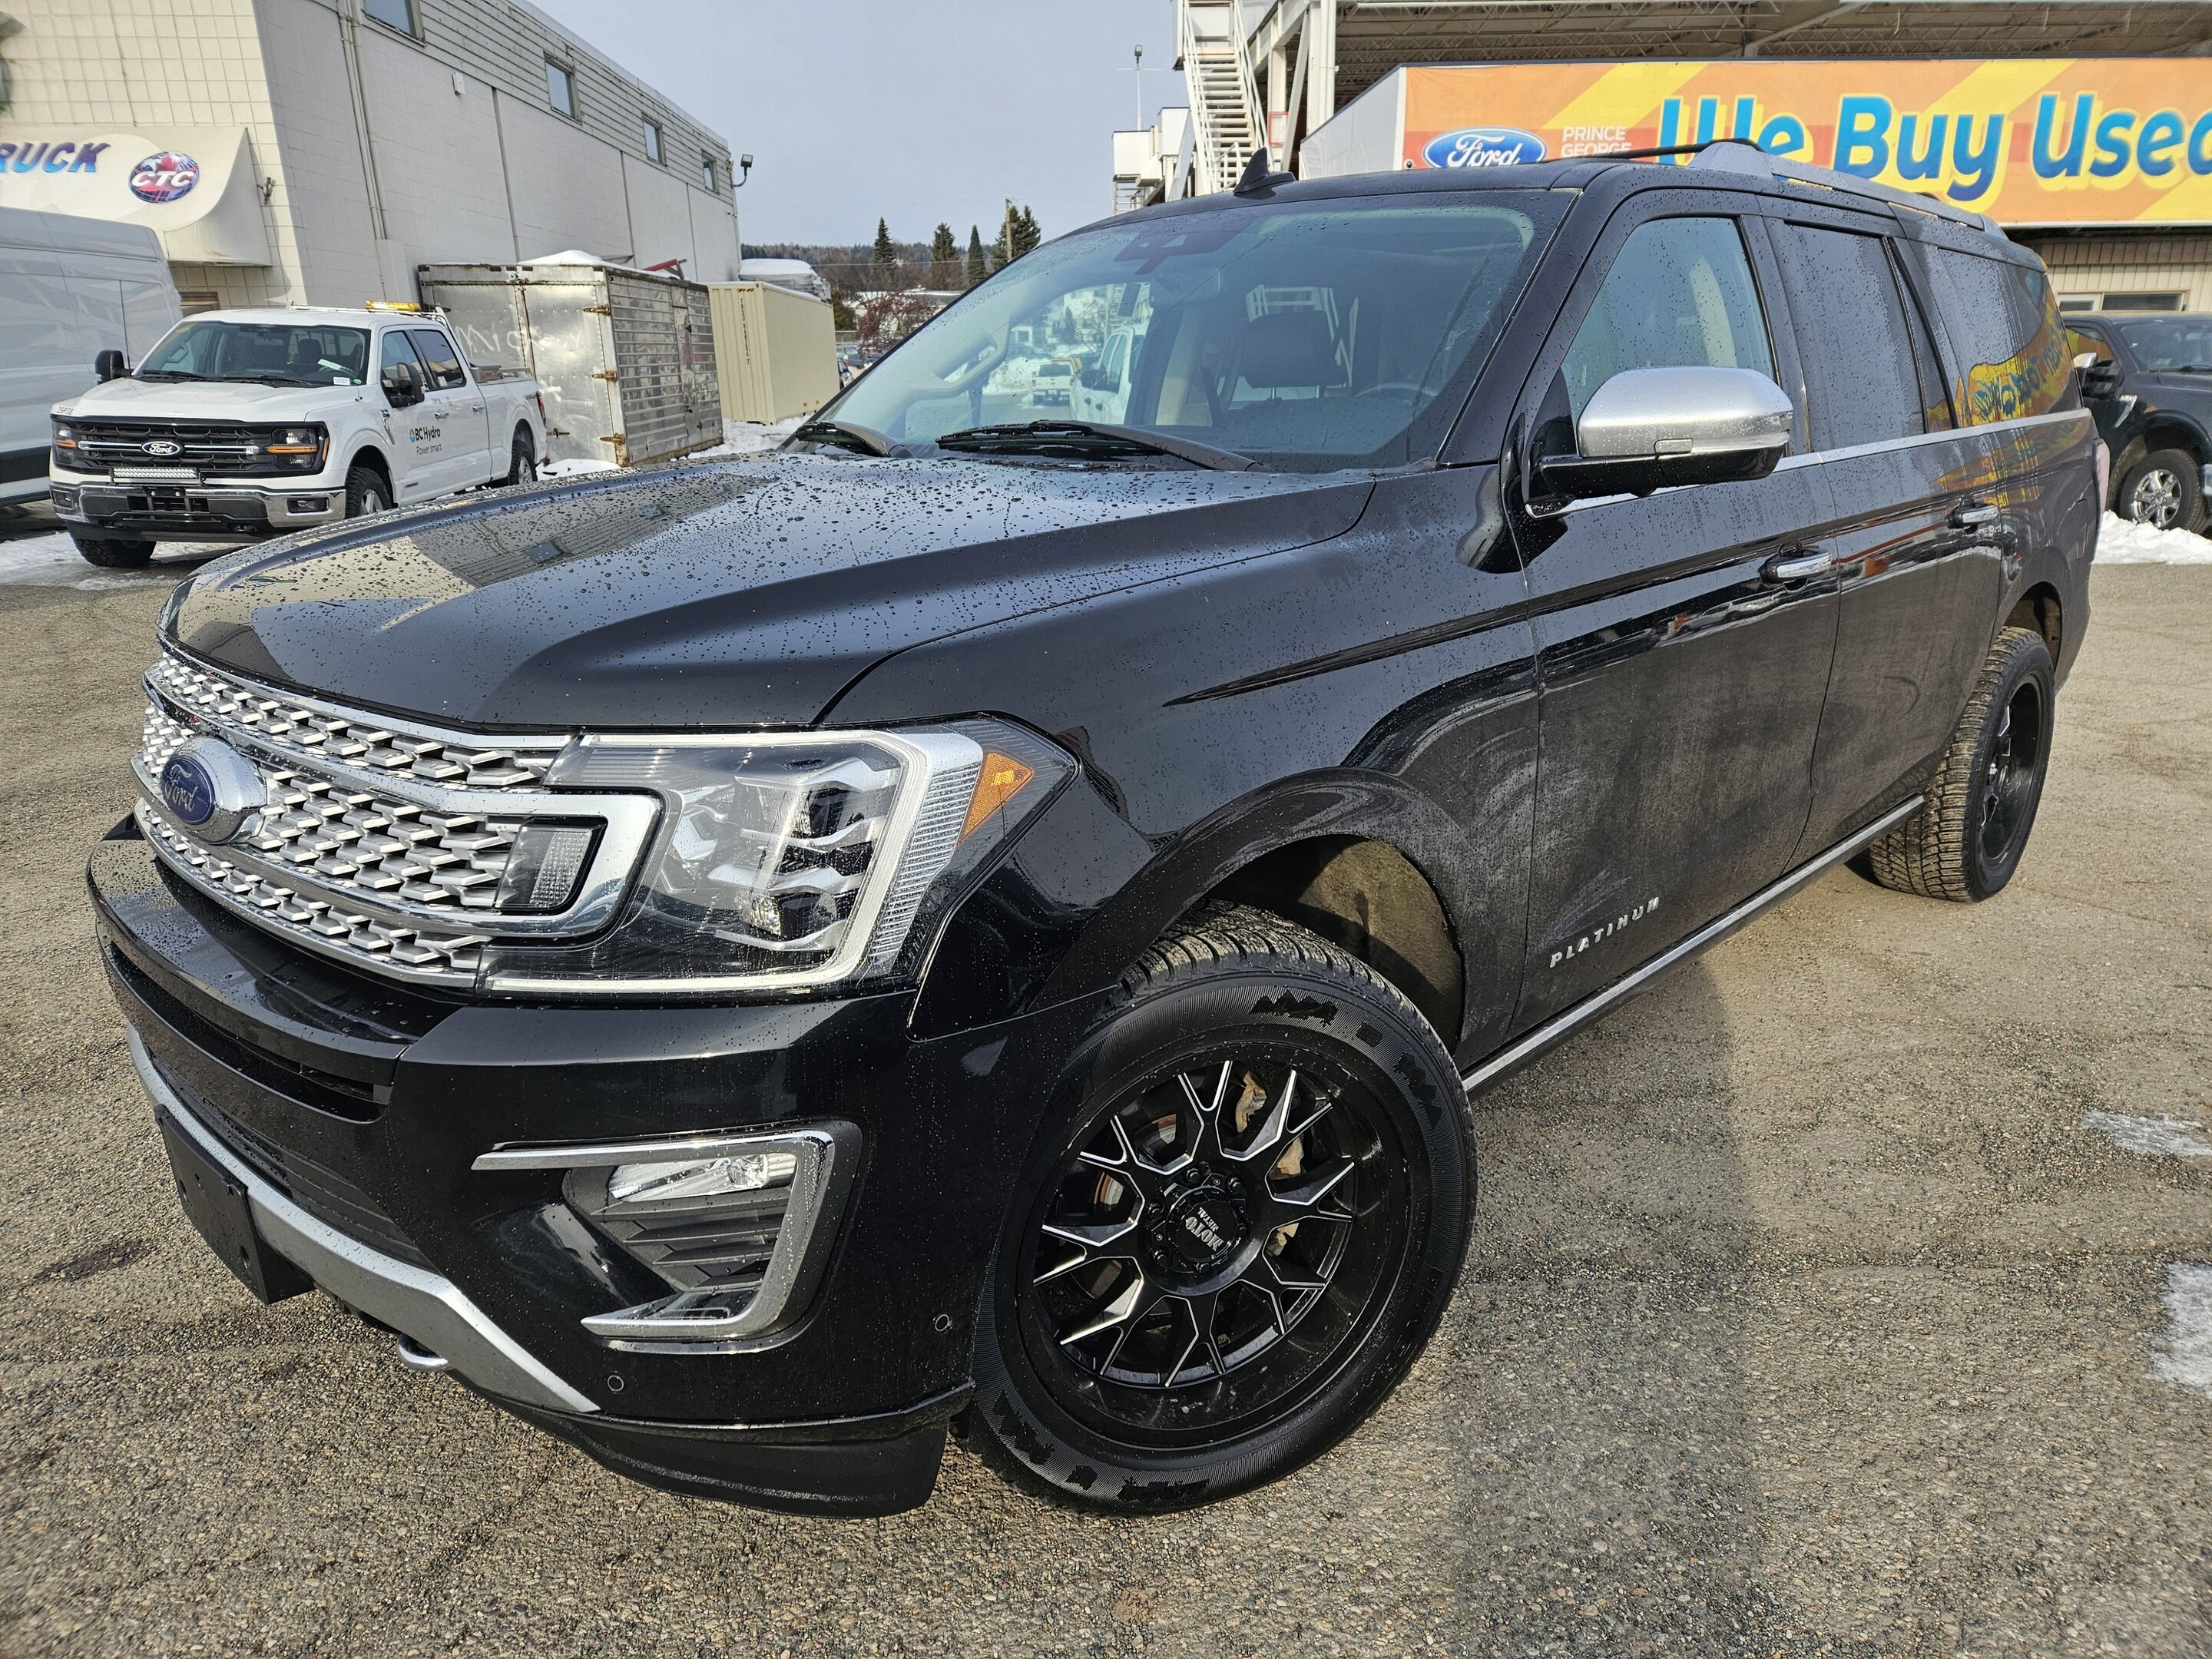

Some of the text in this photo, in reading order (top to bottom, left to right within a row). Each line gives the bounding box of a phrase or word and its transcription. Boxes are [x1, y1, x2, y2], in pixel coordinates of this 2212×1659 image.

[1561, 126, 1627, 141] PRINCE
[1446, 134, 1523, 167] Ford
[1833, 95, 2005, 201] Buy
[131, 171, 194, 187] CTC
[415, 426, 441, 442] BC Hydro
[149, 442, 173, 453] Ford
[416, 444, 442, 455] Power smart
[164, 763, 199, 813] Ford
[1549, 896, 1660, 968] PLATINUM
[1197, 1207, 1220, 1232] METAL
[1185, 1217, 1224, 1252] MOTO
